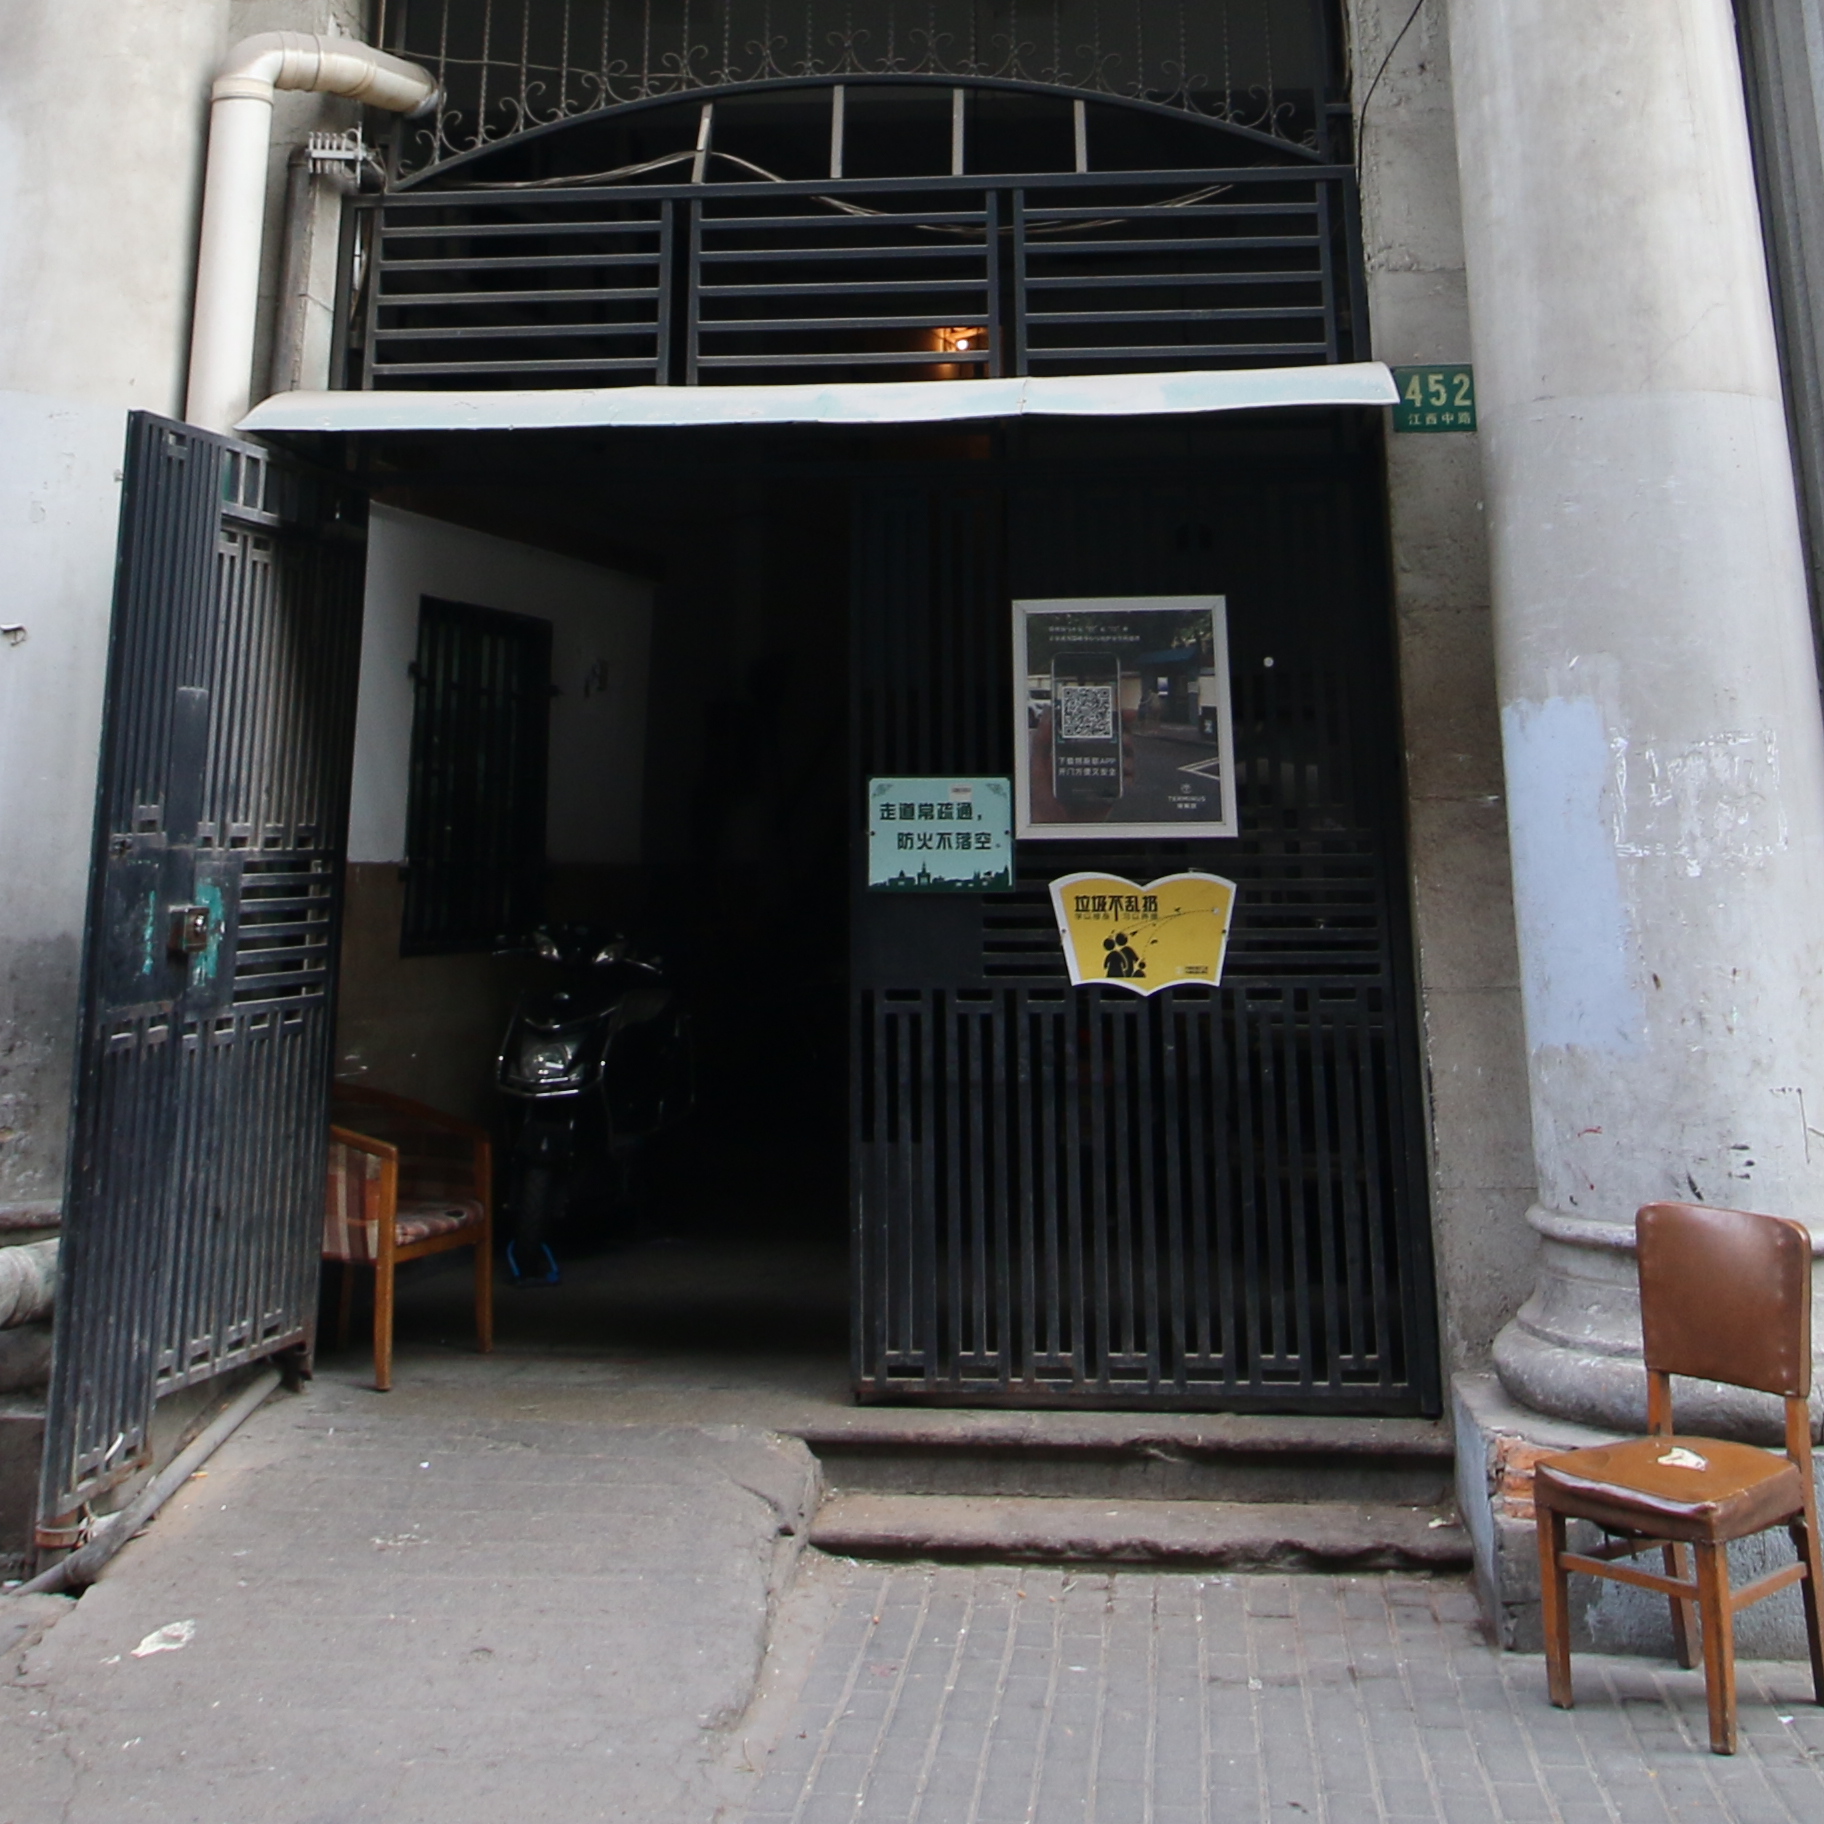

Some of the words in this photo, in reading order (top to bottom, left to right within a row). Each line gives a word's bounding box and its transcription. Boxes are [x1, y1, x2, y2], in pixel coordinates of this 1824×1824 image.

[1405, 373, 1473, 407] 452
[1408, 411, 1471, 426] 江西中路
[1074, 895, 1158, 921] 垃圾不乱扔
